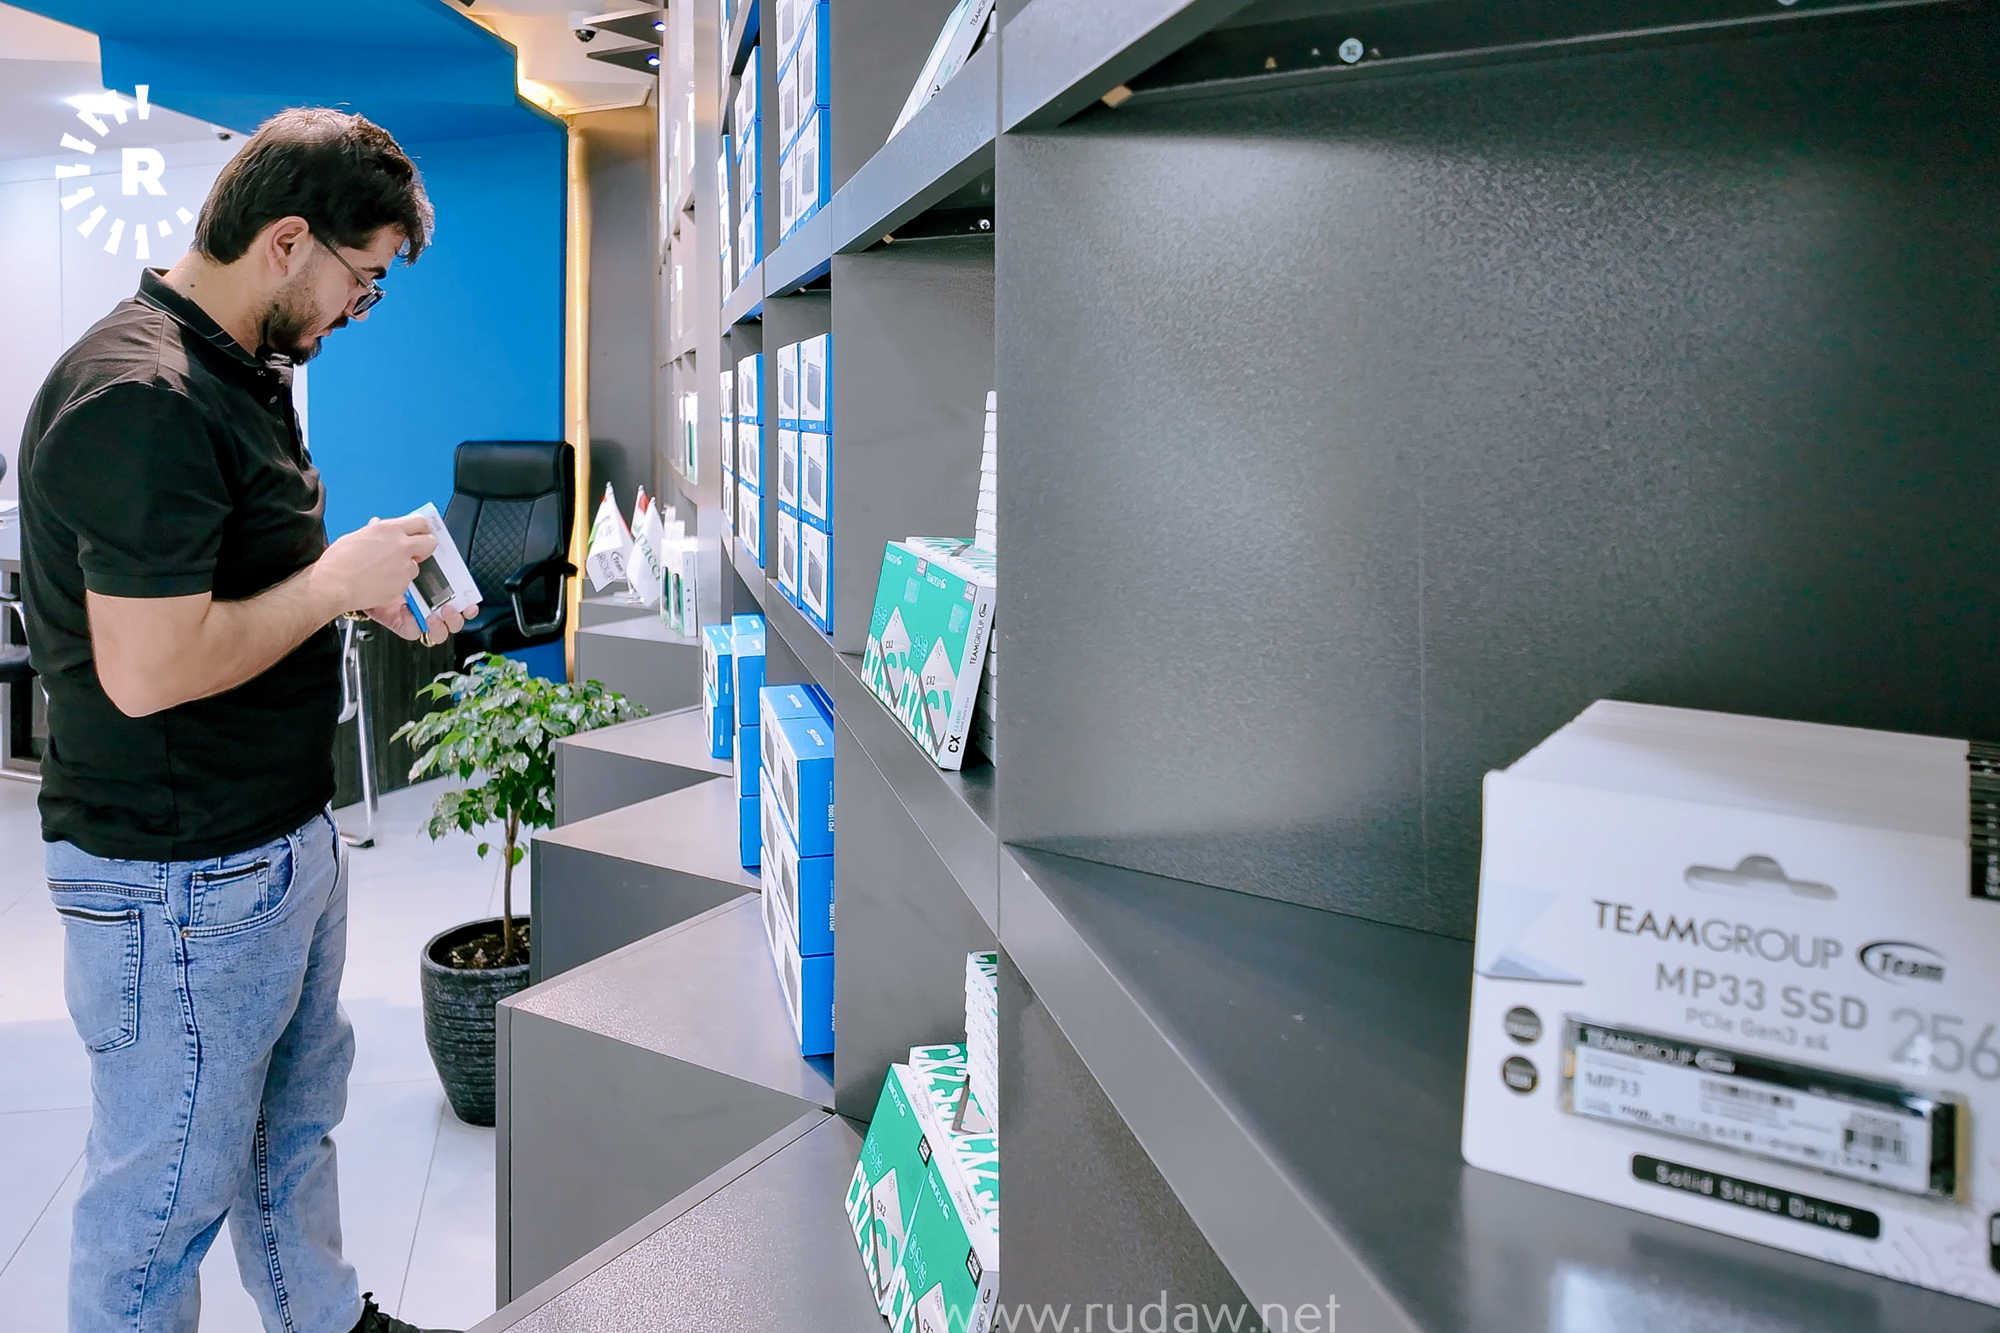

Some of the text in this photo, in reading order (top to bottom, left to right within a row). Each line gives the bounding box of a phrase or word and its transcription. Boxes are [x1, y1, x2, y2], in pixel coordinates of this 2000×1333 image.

[948, 734, 962, 753] CX
[1594, 899, 1843, 970] TEAMGROUP
[1654, 961, 1768, 1012] MP33
[1781, 984, 1869, 1031] SSD
[1741, 1017, 1798, 1047] Gen3
[1656, 1162, 1852, 1231] Solid State Drive
